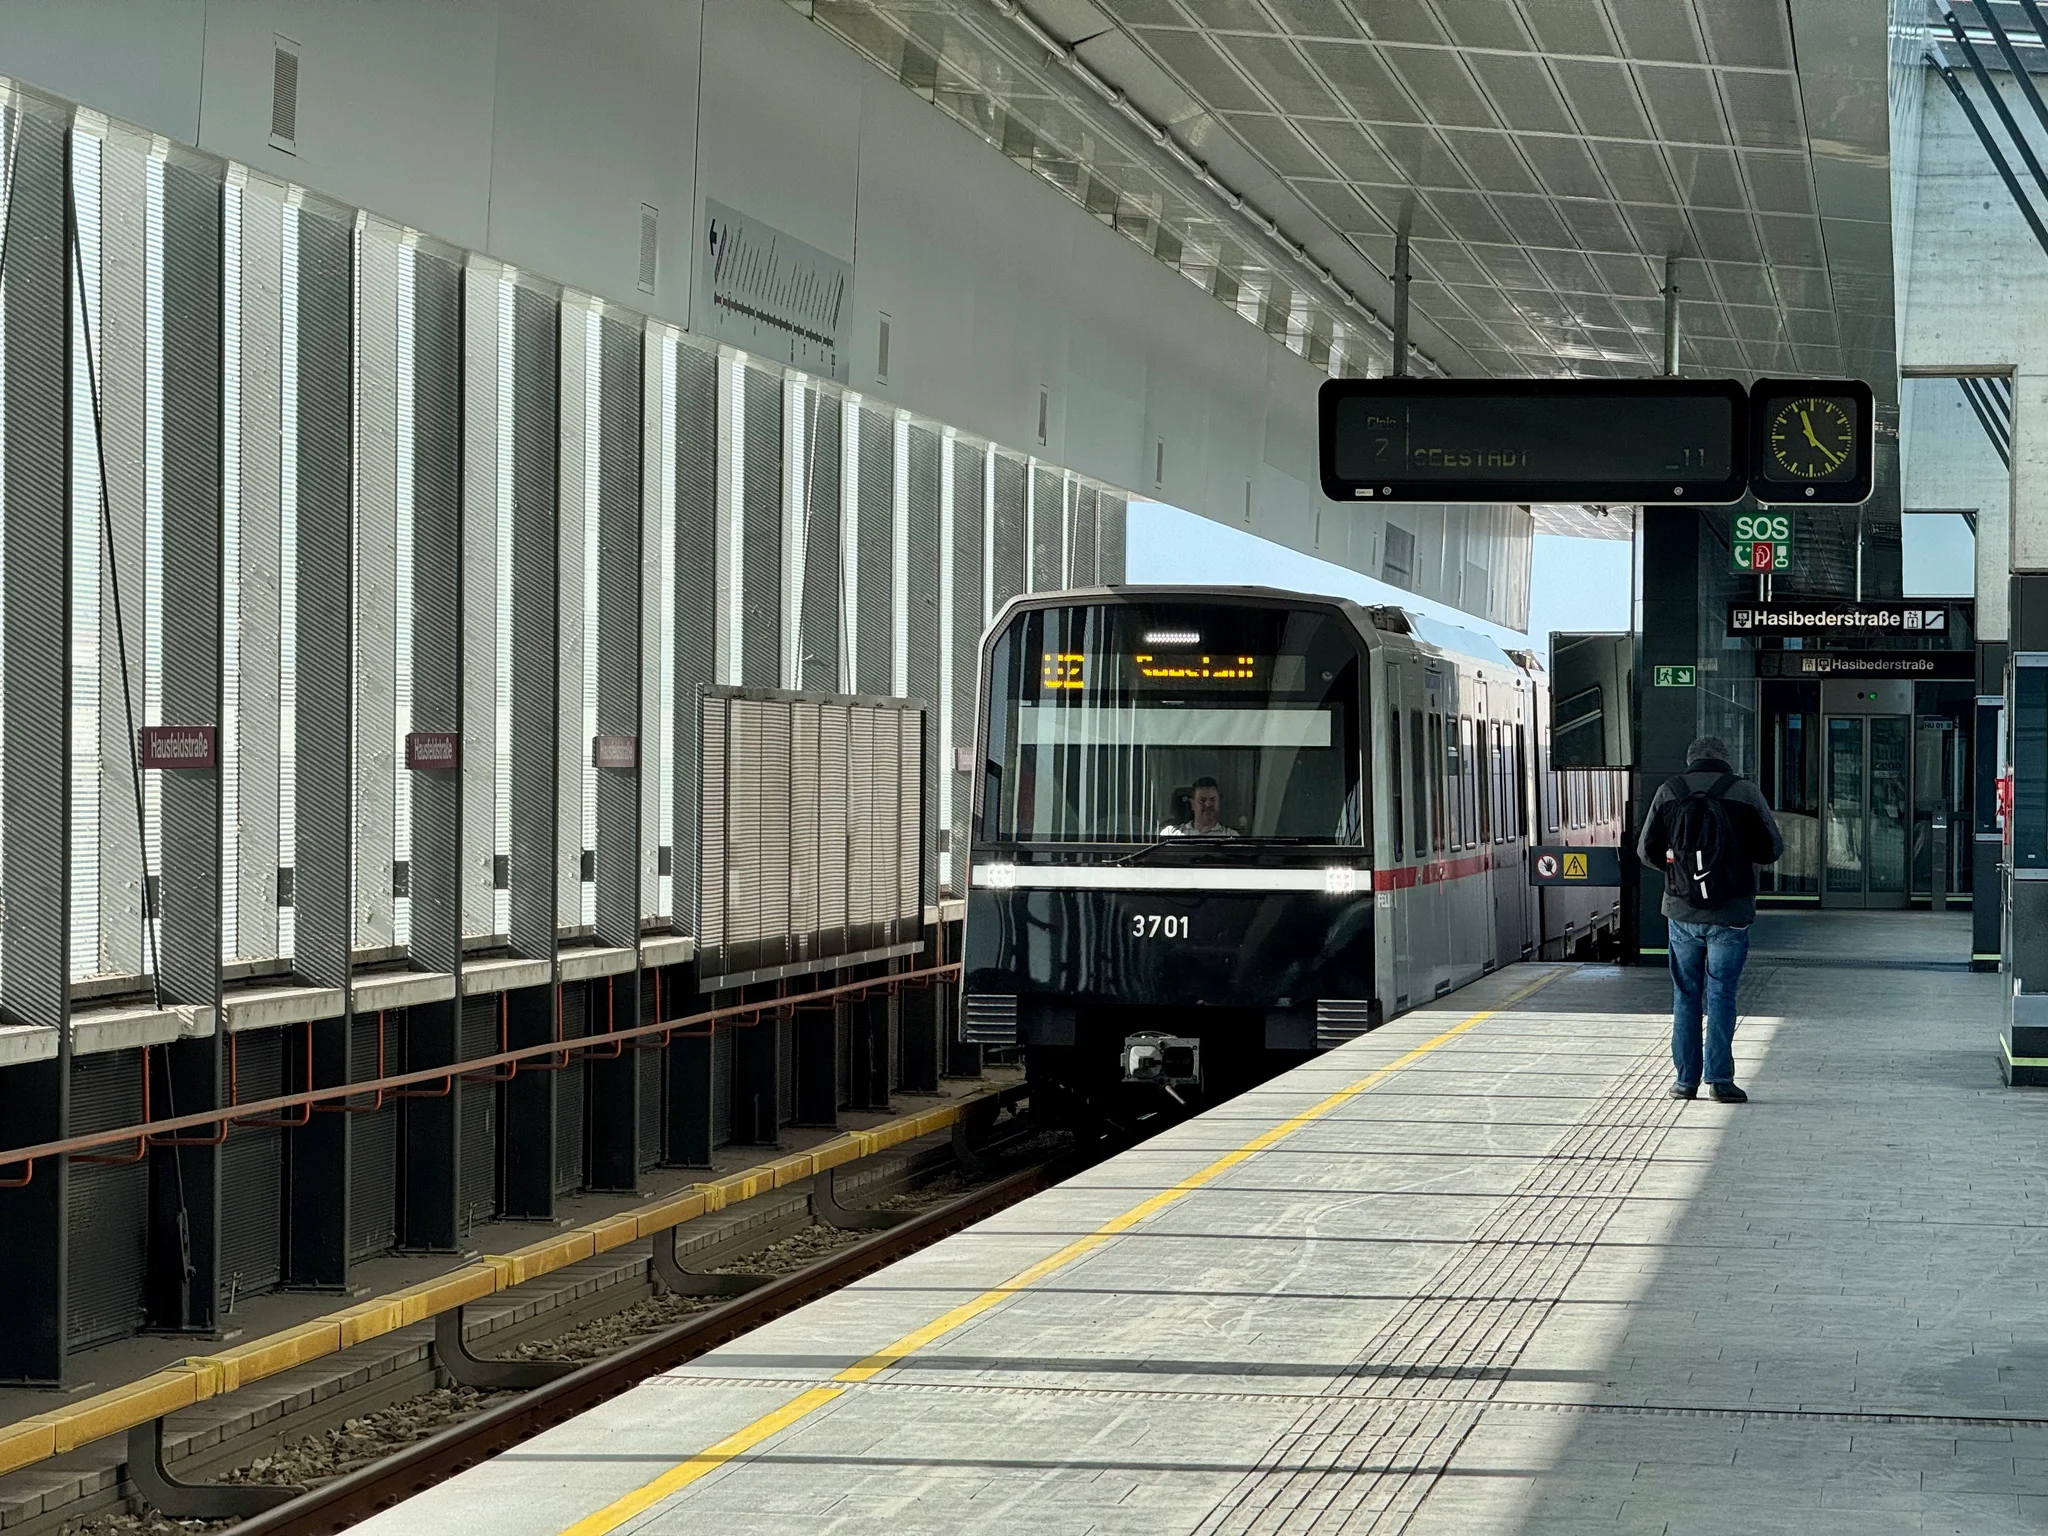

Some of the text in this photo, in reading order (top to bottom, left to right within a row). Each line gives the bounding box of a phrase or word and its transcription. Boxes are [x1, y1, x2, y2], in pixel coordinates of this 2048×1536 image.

[1735, 516, 1789, 540] SOS
[1754, 610, 1901, 627] Hasibederstraße
[1832, 658, 1935, 670] Hasibederstraße
[150, 731, 209, 758] Hausfeldstraße
[1132, 914, 1189, 939] 3701
